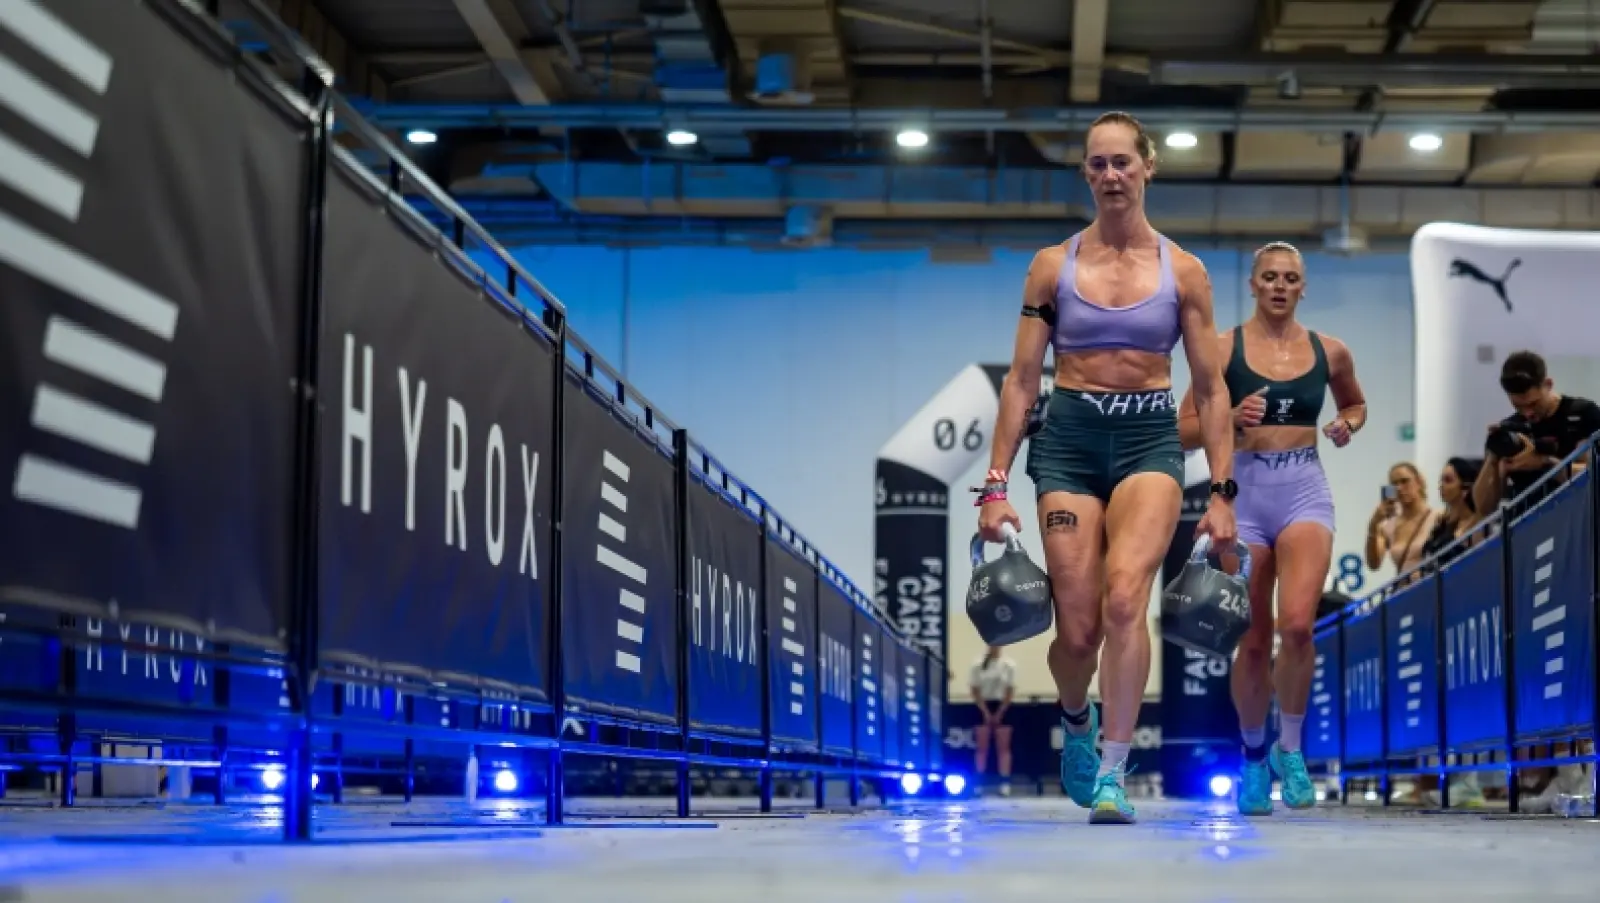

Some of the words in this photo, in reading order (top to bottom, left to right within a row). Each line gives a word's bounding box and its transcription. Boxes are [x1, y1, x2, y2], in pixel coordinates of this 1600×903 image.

[340, 332, 540, 581] HYROX
[932, 418, 984, 452] 06
[692, 555, 758, 667] HYROX
[1445, 605, 1502, 692] HYROX
